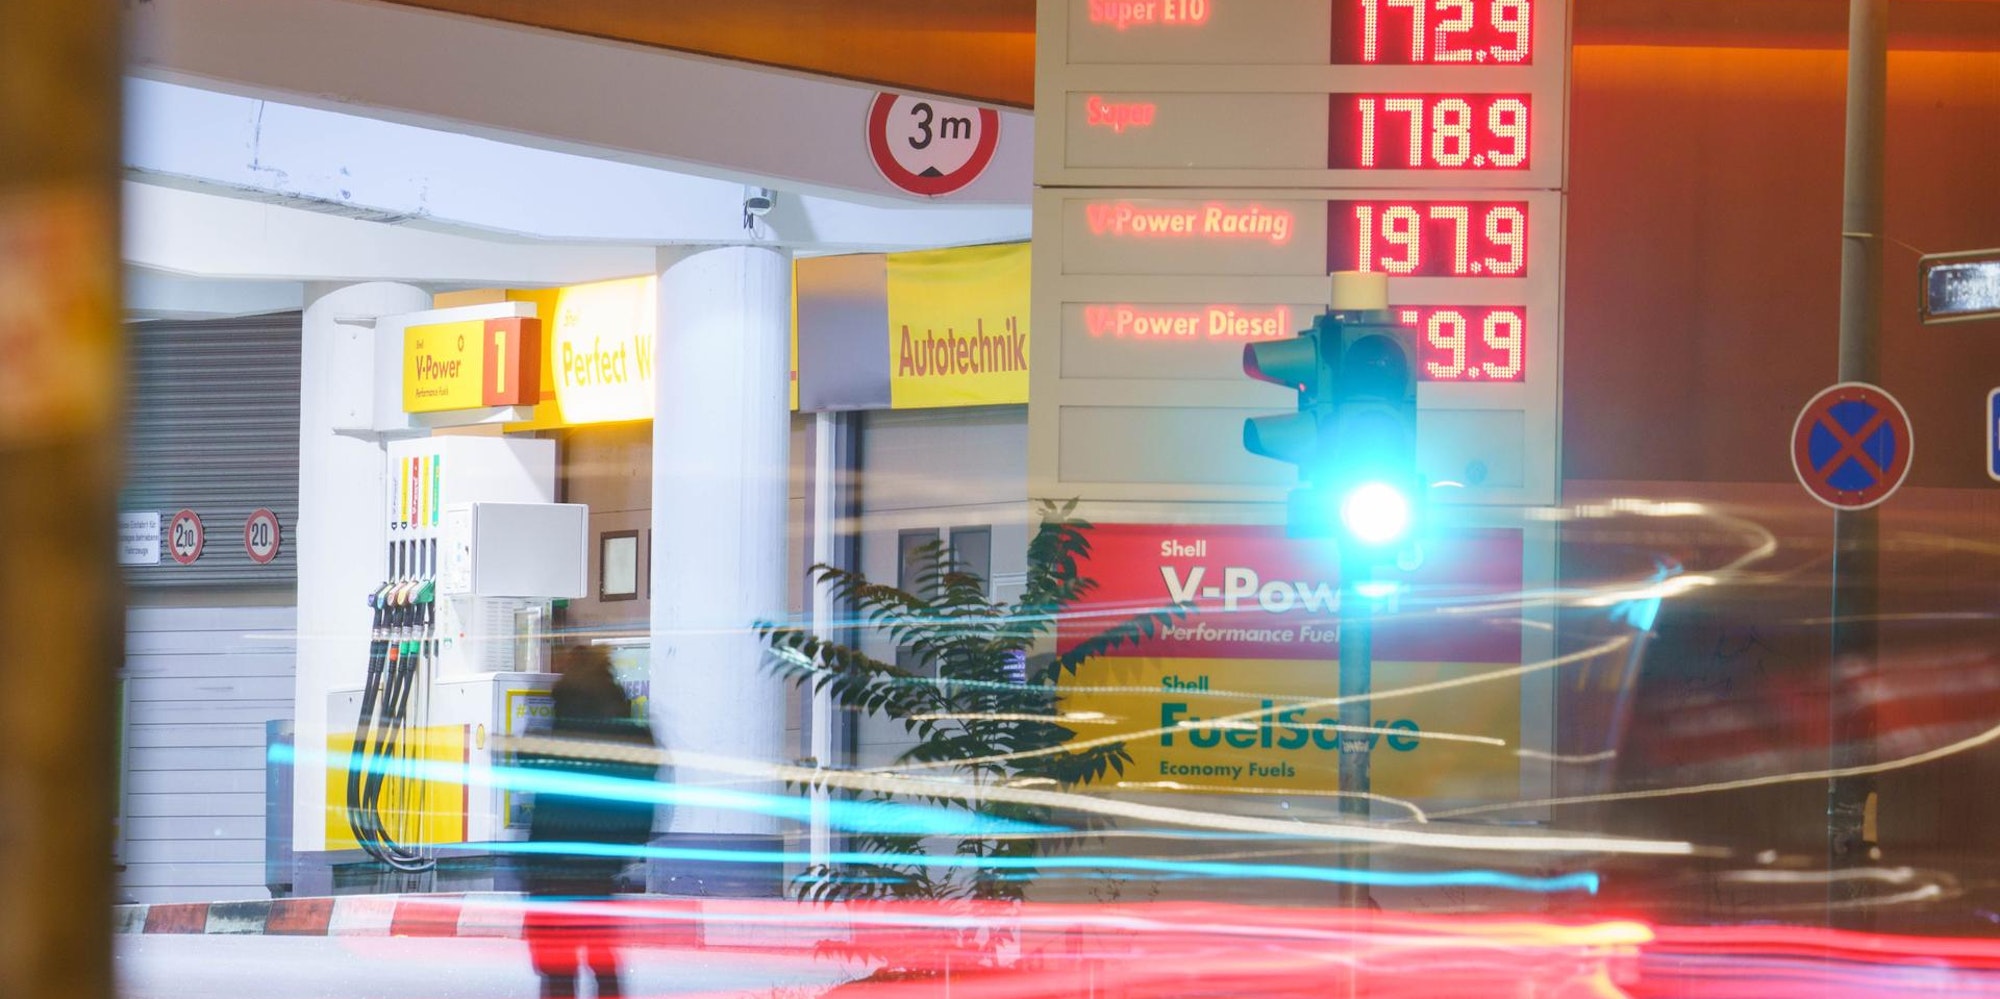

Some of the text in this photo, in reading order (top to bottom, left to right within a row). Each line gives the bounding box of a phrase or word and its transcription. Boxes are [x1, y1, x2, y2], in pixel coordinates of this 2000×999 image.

[1090, 0, 1206, 30] Super E10
[1361, 0, 1530, 62] 172.9
[908, 103, 971, 150] 3 m
[1088, 96, 1155, 131] Super
[1358, 98, 1528, 167] 178.9
[1088, 205, 1290, 241] V-Power Racing
[1355, 205, 1525, 275] 197.9
[1087, 308, 1287, 337] V-Power Diesel
[494, 330, 507, 394] 1
[562, 334, 628, 387] Perfect
[899, 316, 1028, 378] Autotechnik
[1402, 310, 1522, 379] 9.9
[1160, 539, 1207, 557] Shell
[1160, 622, 1294, 643] Performance
[1161, 675, 1210, 693] Shell
[1159, 760, 1296, 781] Economy Fuels
